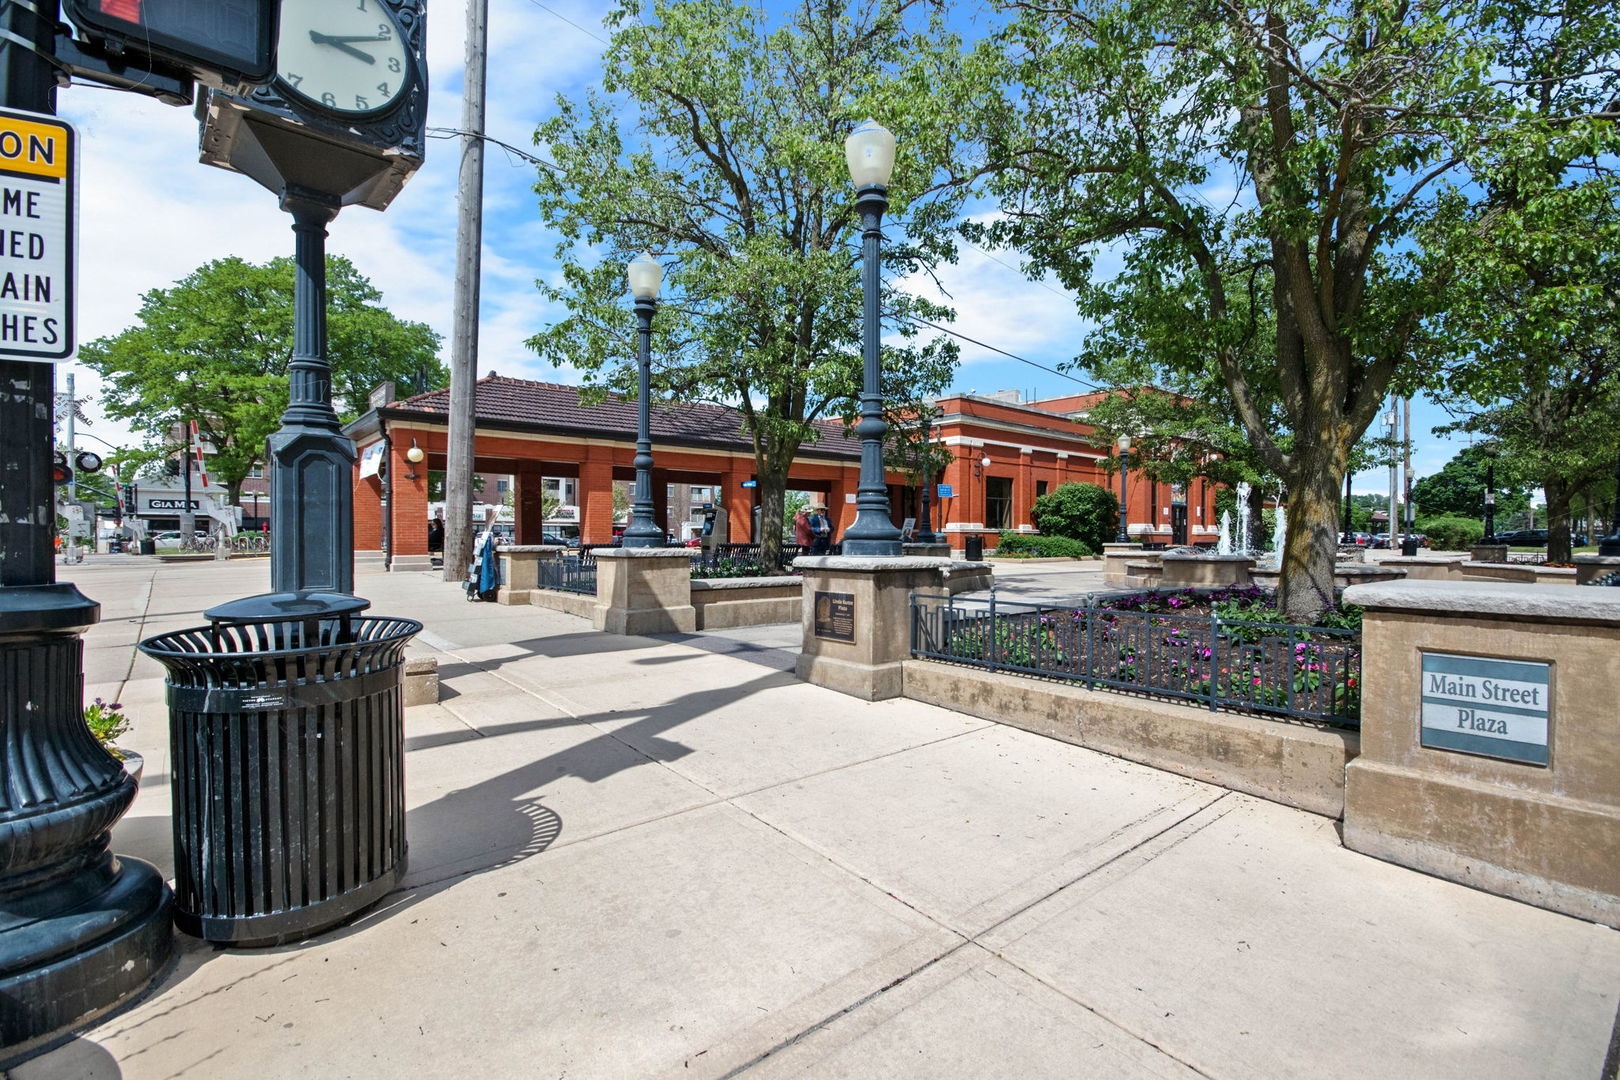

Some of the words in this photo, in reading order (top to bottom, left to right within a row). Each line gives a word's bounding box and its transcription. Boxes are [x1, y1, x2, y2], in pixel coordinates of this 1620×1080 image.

[378, 24, 391, 41] 2
[388, 57, 401, 73] 3
[288, 72, 303, 89] 7
[377, 82, 391, 98] 4
[321, 92, 337, 109] 6
[355, 94, 369, 110] 5
[0, 229, 45, 260] ED
[0, 272, 51, 303] AIN
[2, 313, 58, 345] HES
[151, 500, 173, 508] GIA
[174, 500, 197, 509] MA
[1429, 674, 1477, 698] Main
[1482, 680, 1540, 705] Street
[1457, 709, 1508, 735] Plaza
